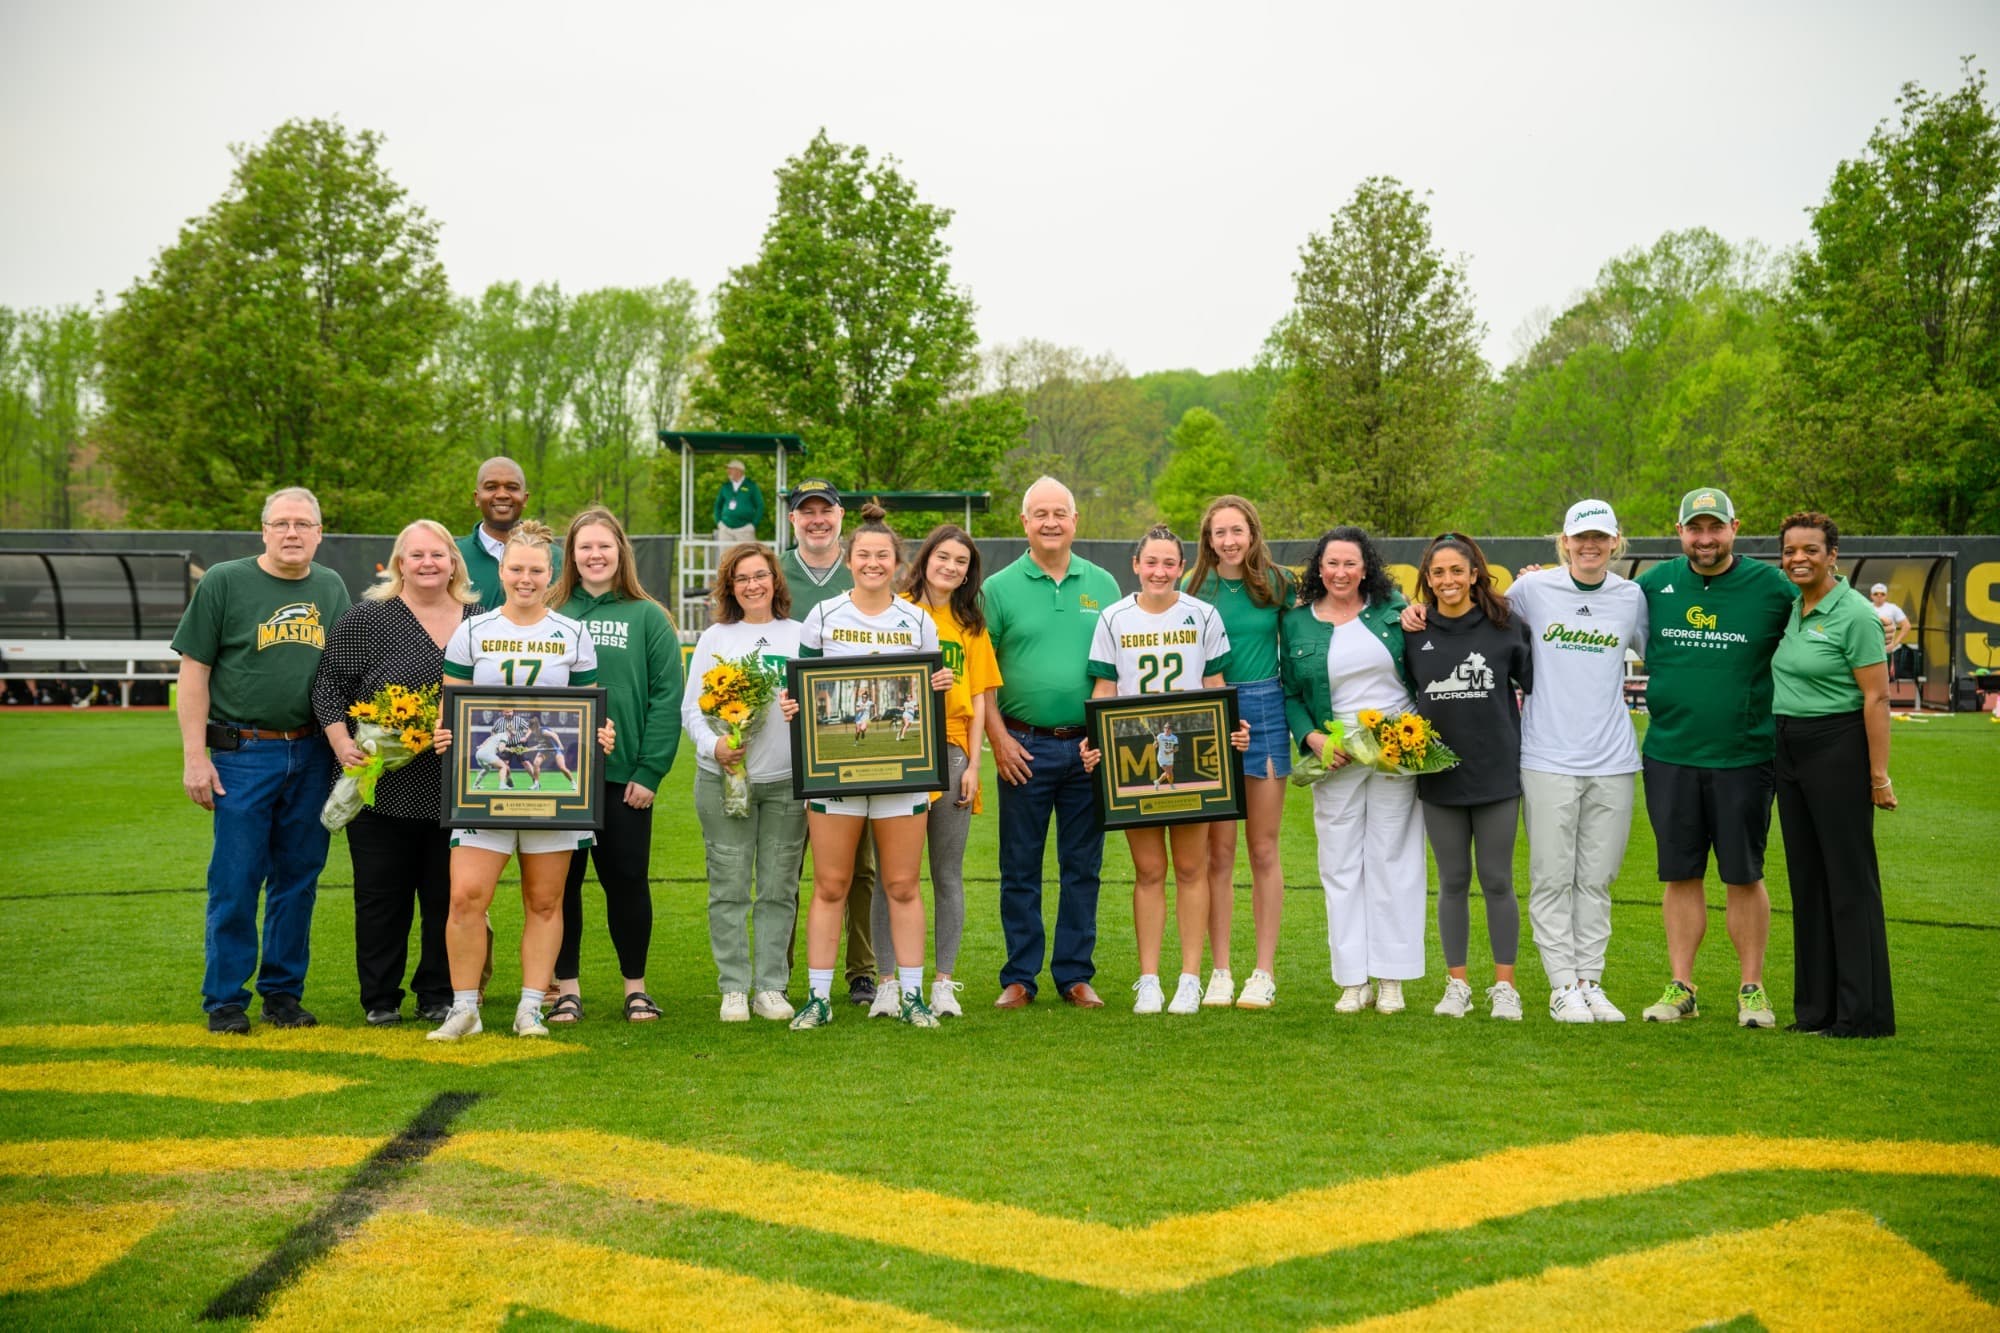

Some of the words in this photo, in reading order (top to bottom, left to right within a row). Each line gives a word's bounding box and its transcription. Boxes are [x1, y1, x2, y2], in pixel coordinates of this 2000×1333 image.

[1686, 606, 1717, 630] GM
[260, 624, 324, 646] MASON
[588, 620, 629, 637] SON
[1543, 623, 1619, 648] Patriots
[1661, 628, 1703, 640] GEORGE
[832, 629, 873, 644] GEORGE
[877, 632, 913, 646] MASON
[1121, 633, 1159, 648] GEORGE
[1163, 630, 1197, 646] MASON
[1674, 640, 1728, 650] LACROSSE
[481, 639, 523, 653] GEORGE
[527, 641, 565, 656] MASON
[1555, 643, 1605, 654] LACROSSE
[500, 658, 542, 687] 17
[1137, 651, 1184, 694] 22
[1430, 690, 1489, 700] LACROSSE
